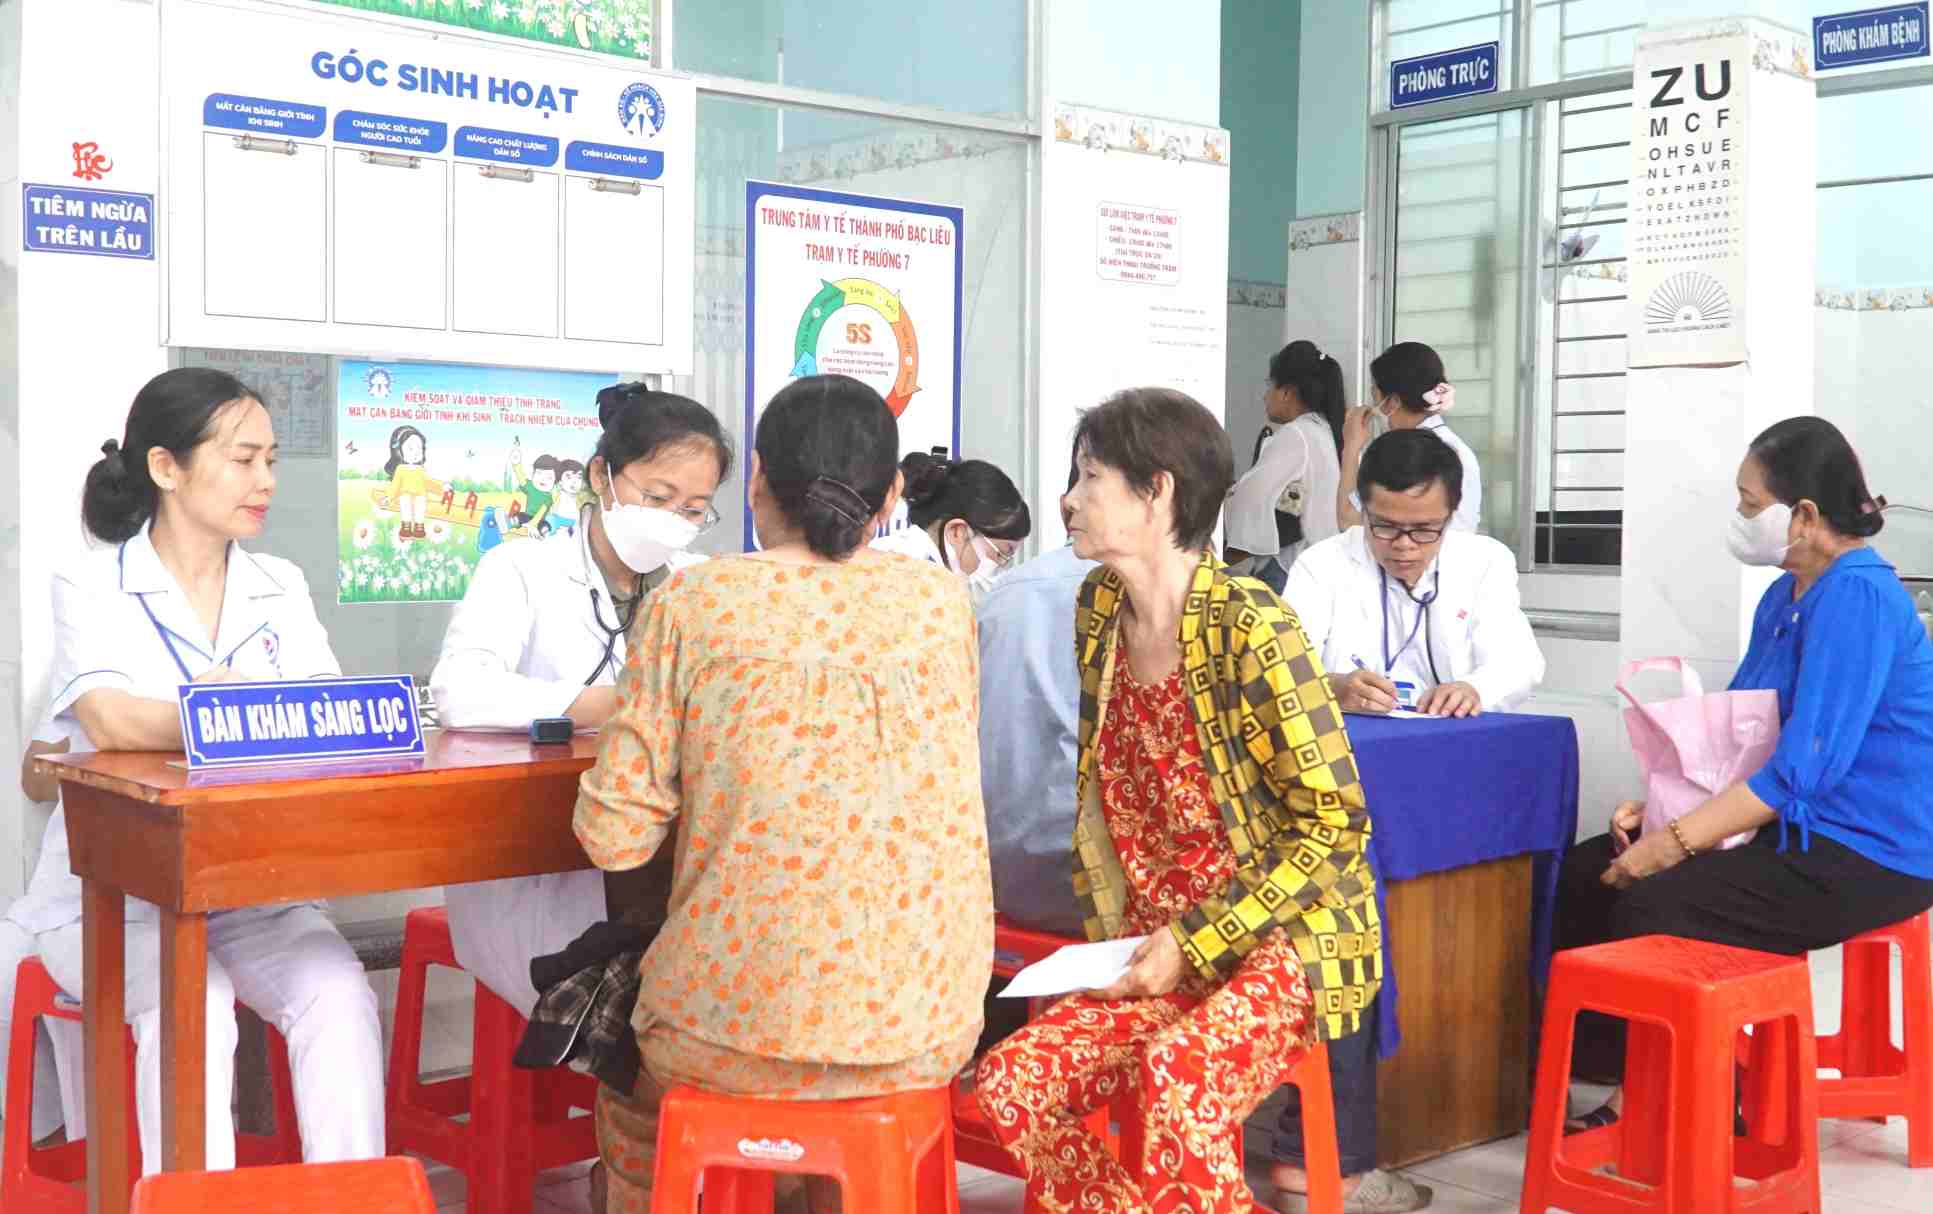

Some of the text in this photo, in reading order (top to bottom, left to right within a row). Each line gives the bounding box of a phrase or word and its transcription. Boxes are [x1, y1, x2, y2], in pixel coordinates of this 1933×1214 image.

[1823, 15, 1920, 54] PHÒNG KHÁM BỆNH
[311, 48, 389, 87] GÓC
[397, 63, 478, 100] SINH
[488, 76, 579, 119] HOẠT
[1399, 56, 1489, 95] PHÒNG TRỰC
[30, 194, 148, 223] TIÊM NGỪA
[761, 207, 796, 228] TRUNG
[798, 207, 820, 231] TÂM
[824, 215, 831, 231] Y
[833, 210, 846, 234] TẾ
[885, 219, 904, 241] PHỐ
[908, 224, 926, 246] BẠC
[929, 225, 951, 246] LIÊU
[36, 224, 141, 250] TRÊN LẦU
[837, 247, 844, 263] Y
[847, 243, 860, 265] TẾ
[904, 255, 910, 270] 7
[846, 322, 872, 344] 5S
[197, 691, 407, 744] BÀN KHÁM SÀNG LỌC
